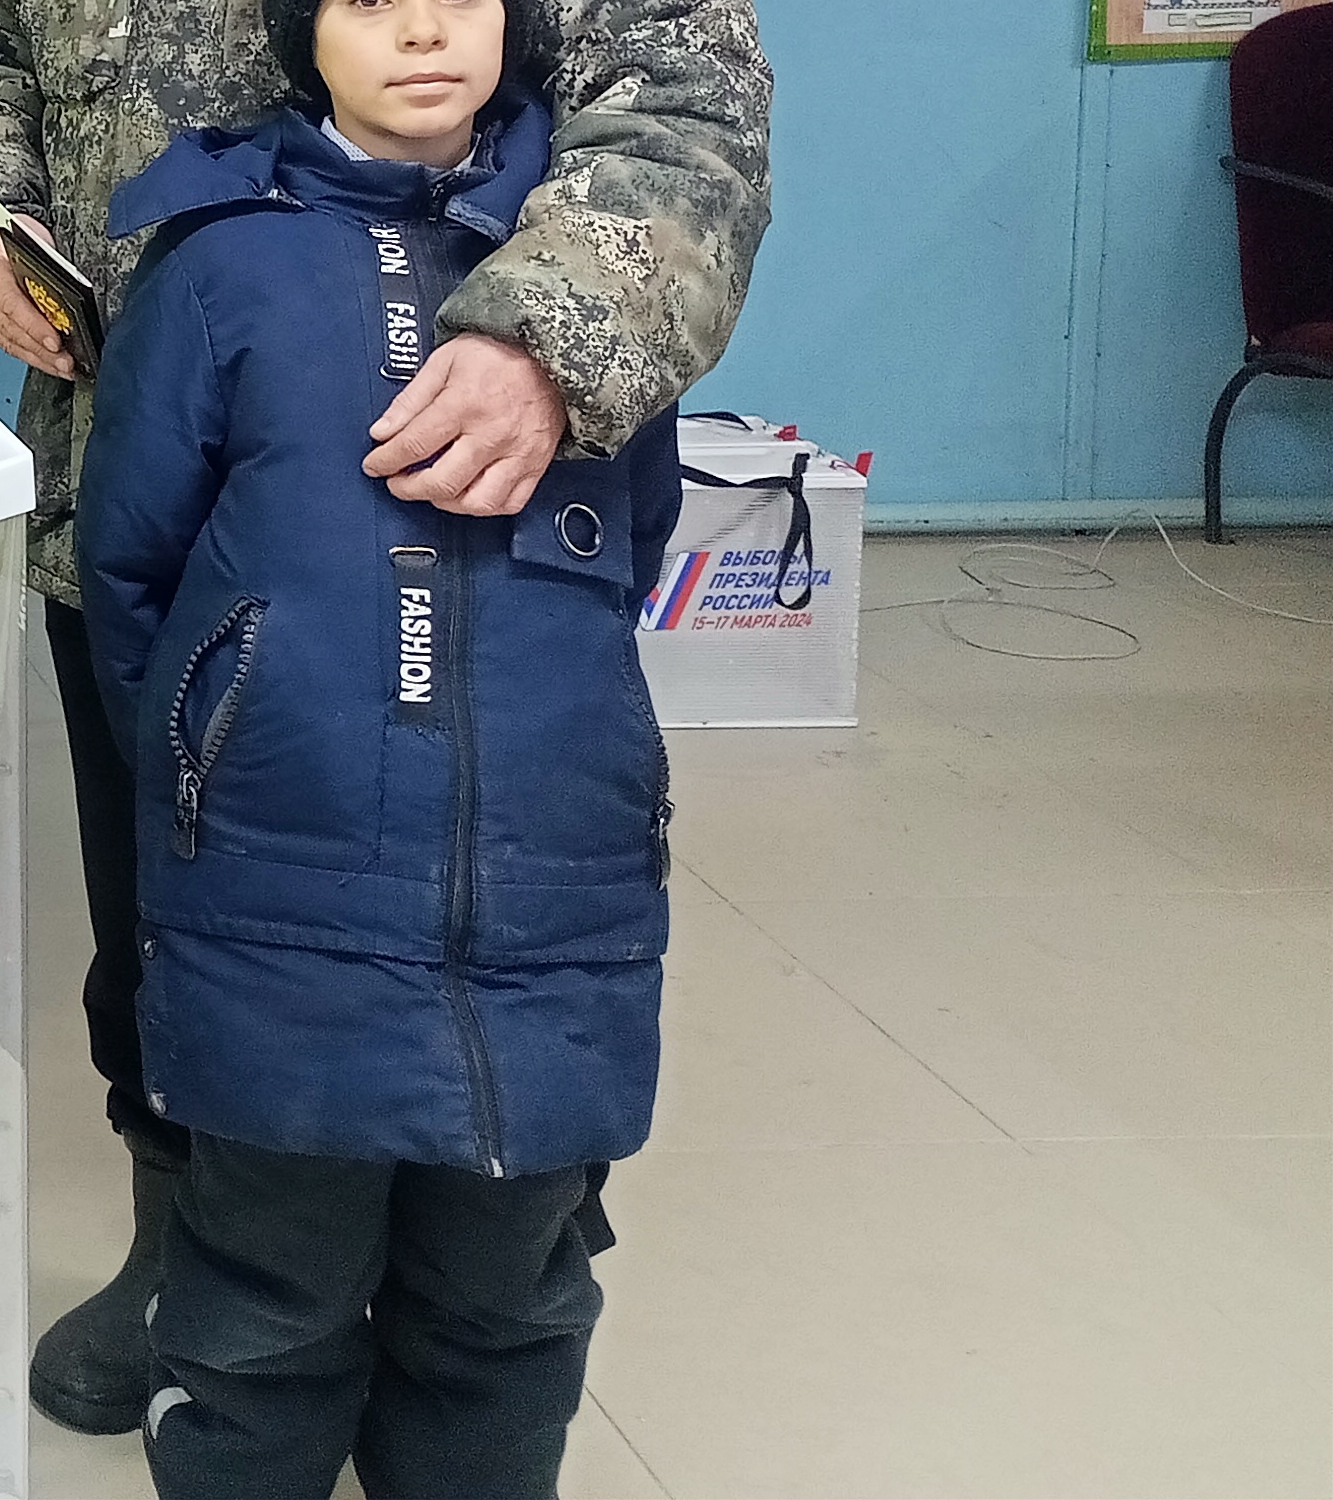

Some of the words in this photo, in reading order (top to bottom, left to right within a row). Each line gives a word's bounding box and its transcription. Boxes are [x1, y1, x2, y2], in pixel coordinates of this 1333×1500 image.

[698, 593, 776, 611] РОССИИ
[730, 614, 777, 630] МАРТА
[779, 613, 813, 628] 2024
[399, 587, 432, 703] FASHION
